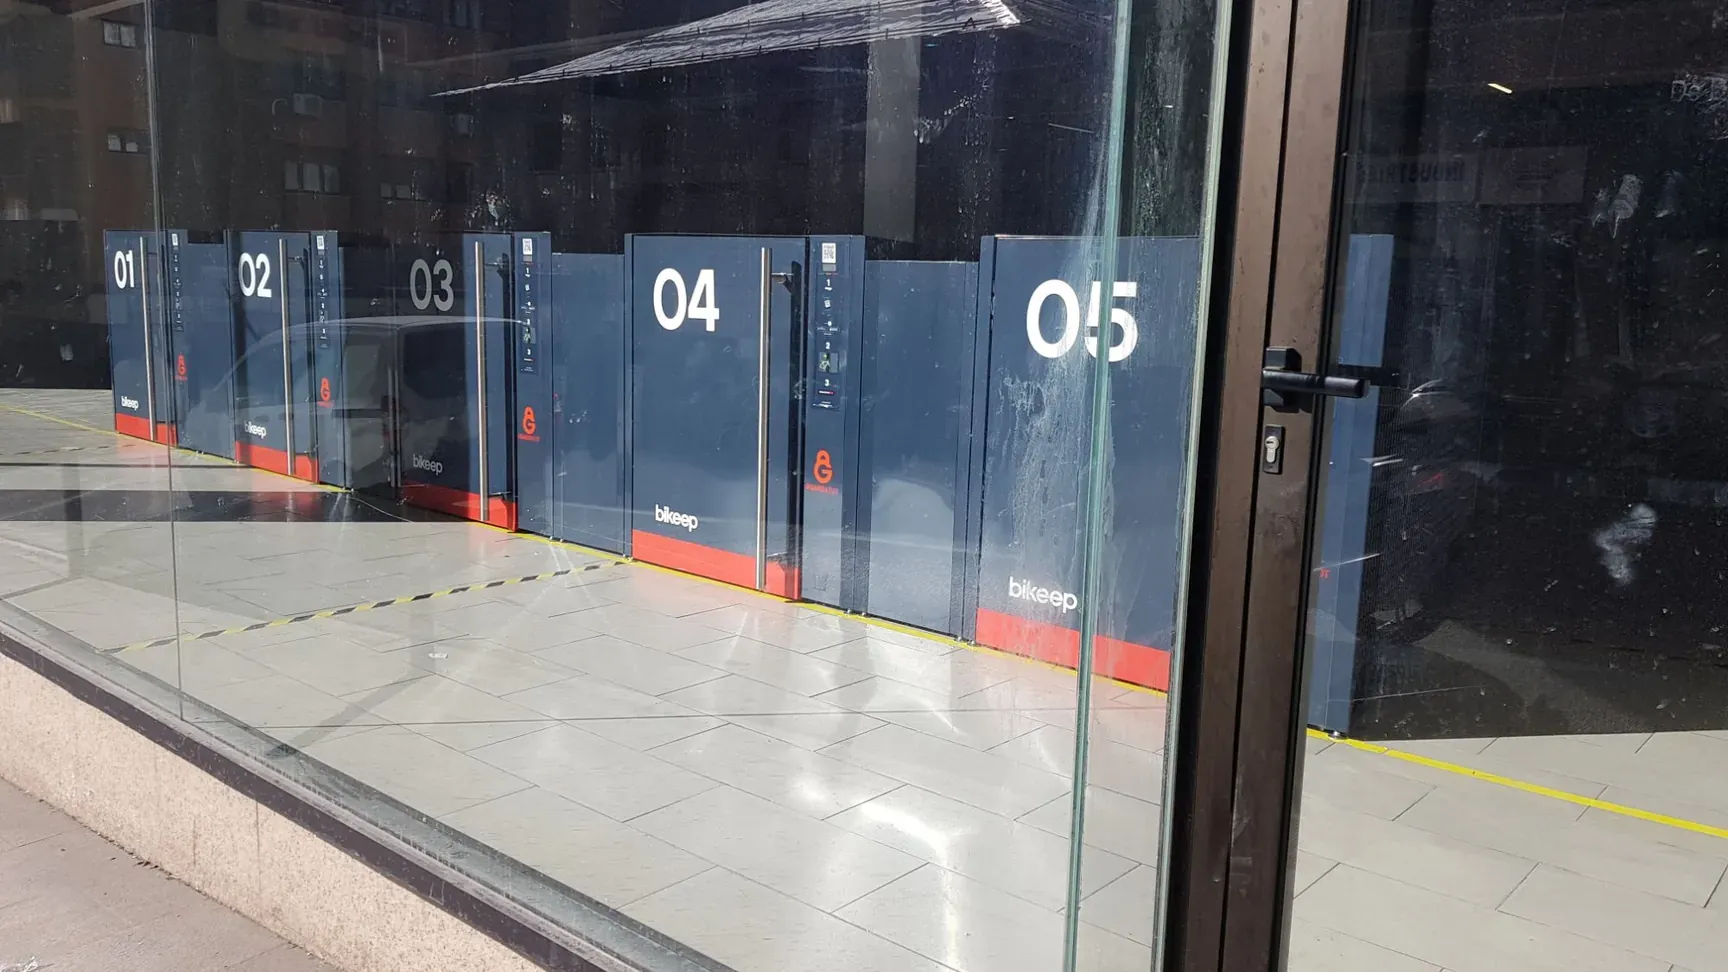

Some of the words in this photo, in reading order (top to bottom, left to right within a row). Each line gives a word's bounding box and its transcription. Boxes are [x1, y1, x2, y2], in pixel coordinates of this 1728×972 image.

[114, 250, 135, 290] 01
[239, 253, 272, 298] 02
[409, 259, 454, 312] 03
[653, 268, 720, 332] 04
[1026, 279, 1138, 362] 05
[121, 396, 140, 411] bikeep
[244, 420, 267, 439] bikeep
[412, 454, 443, 475] bikeep
[654, 504, 699, 532] bikeep
[1007, 576, 1078, 611] bikeep
